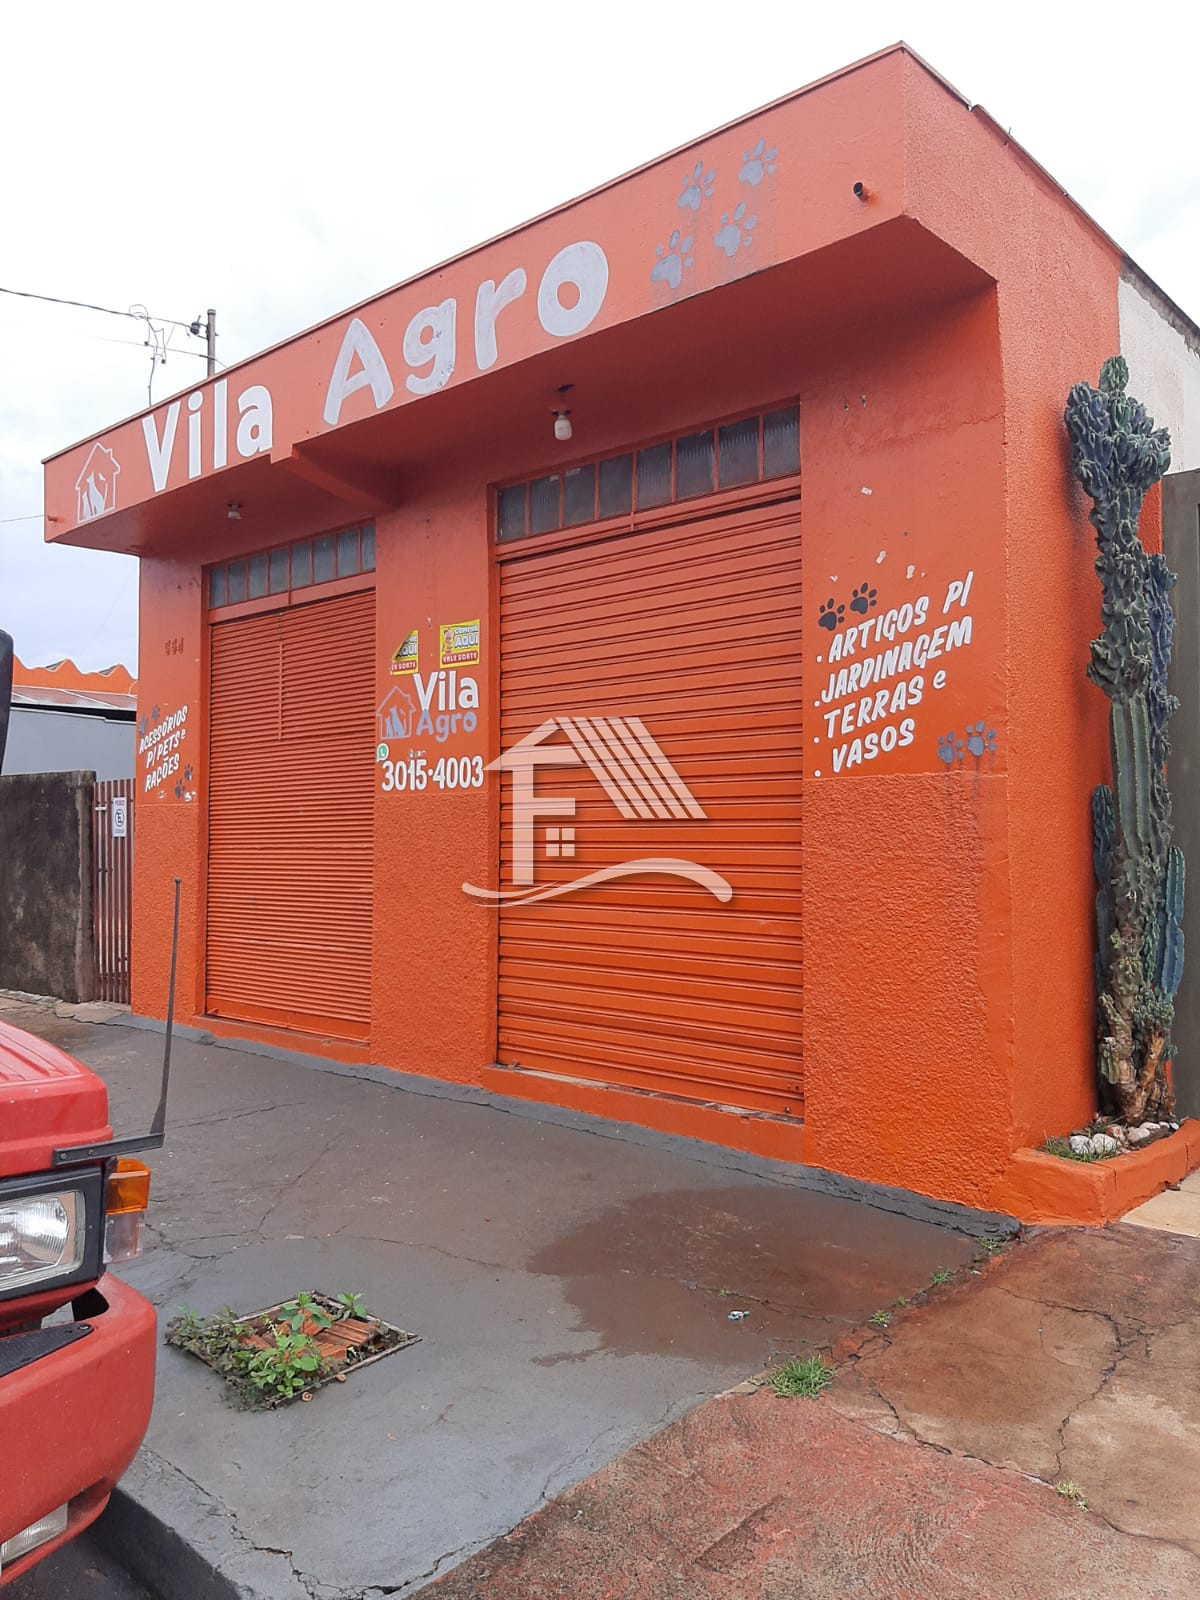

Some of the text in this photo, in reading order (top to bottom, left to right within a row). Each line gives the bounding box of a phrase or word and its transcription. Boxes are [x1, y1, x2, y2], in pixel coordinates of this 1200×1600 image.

[142, 240, 609, 493] Vila Agro
[455, 634, 478, 648] AQUI
[828, 596, 929, 664] ARTIGOS
[821, 615, 972, 703] JARDINAGEM
[413, 670, 479, 711] Vila
[823, 670, 946, 738] TERRAS e
[138, 705, 189, 755] ACESSÓRIOS
[156, 732, 180, 761] PETS
[416, 708, 478, 743] Agro
[832, 718, 915, 773] VASOS
[145, 752, 180, 793] RAÇÕES
